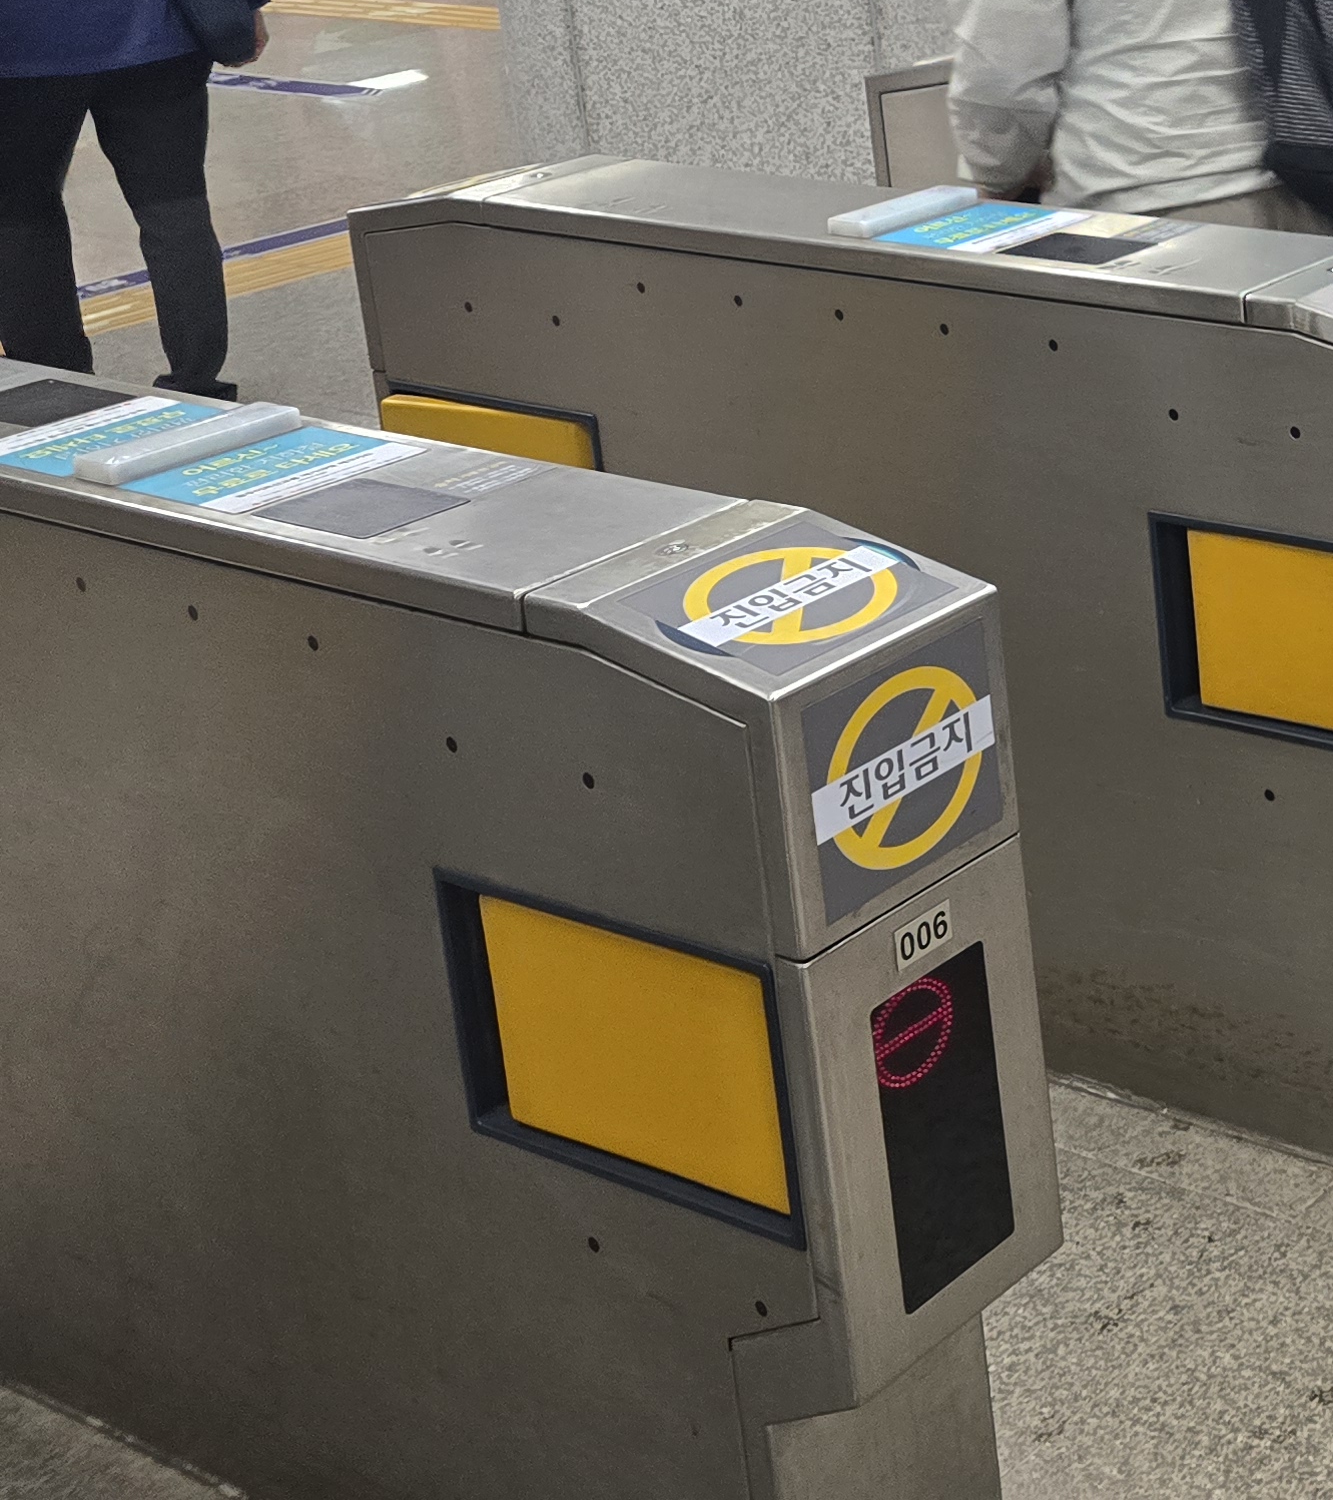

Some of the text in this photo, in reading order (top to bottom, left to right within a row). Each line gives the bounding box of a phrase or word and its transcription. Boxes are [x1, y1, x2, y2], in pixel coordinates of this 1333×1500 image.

[709, 557, 873, 629] 진입금지
[839, 710, 975, 820] 진입금지
[899, 909, 949, 962] 006
